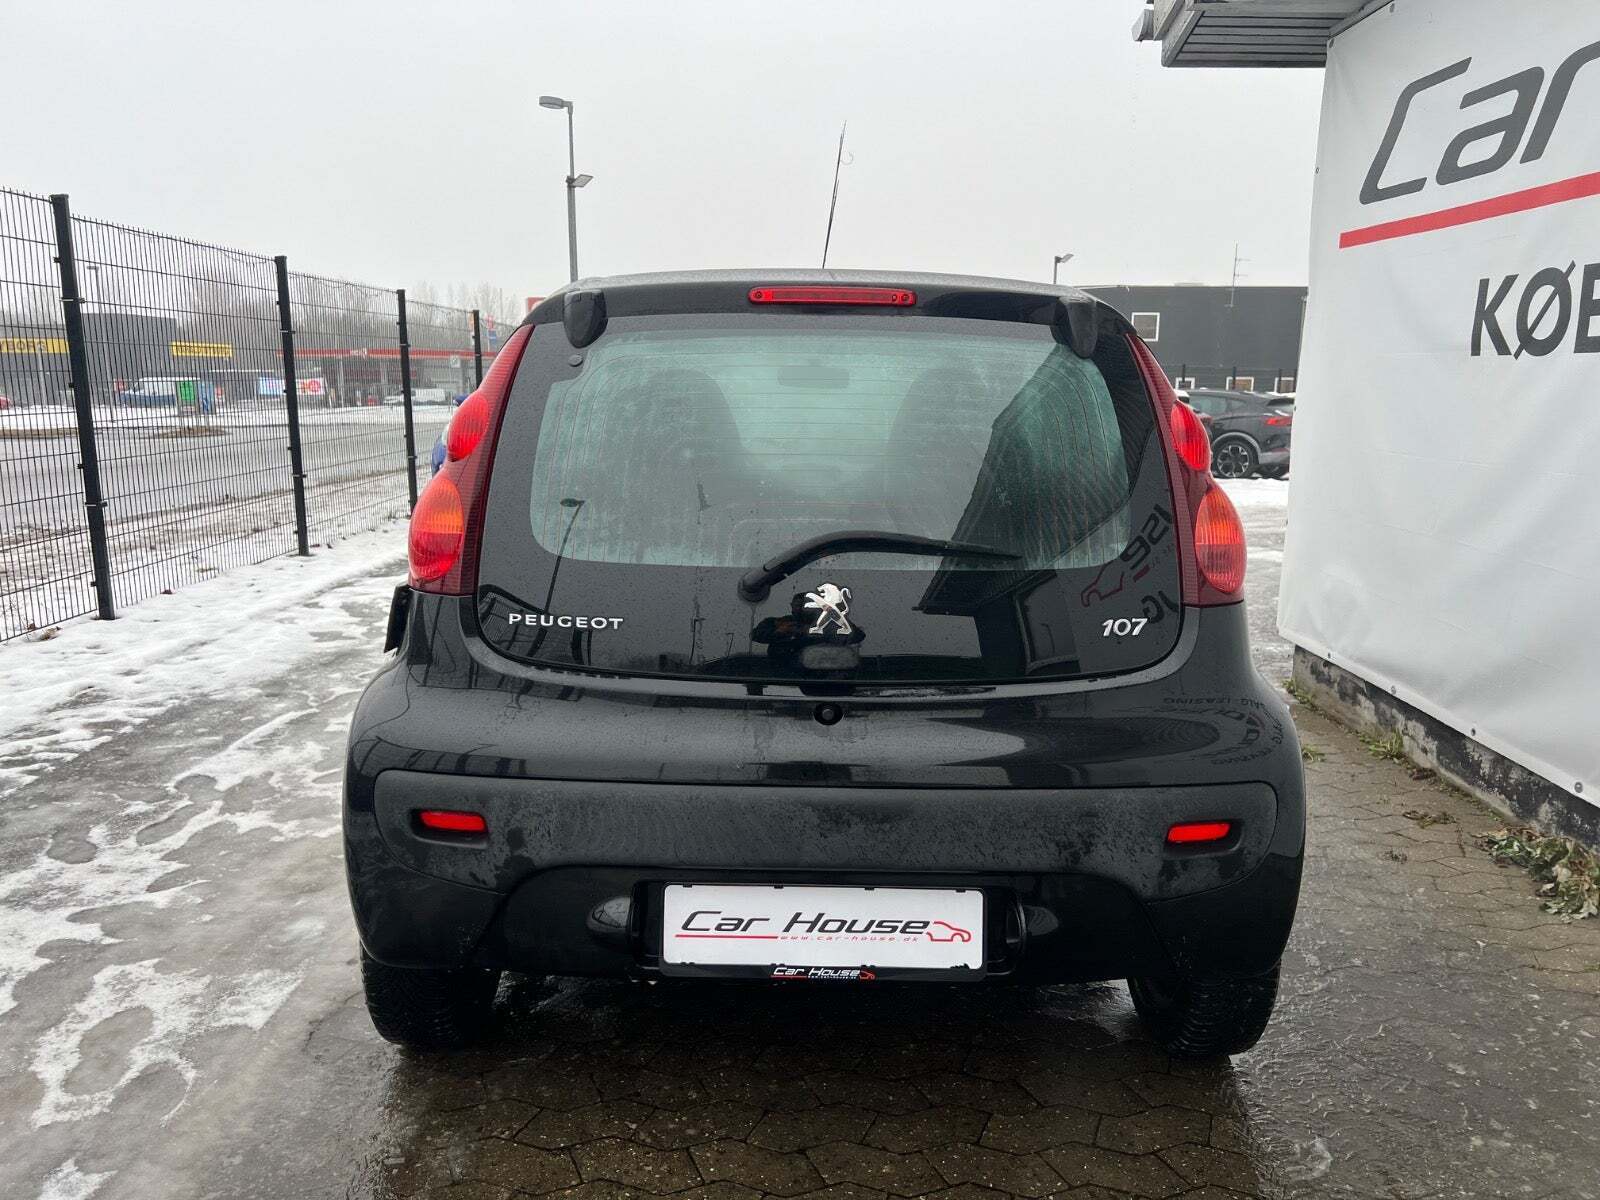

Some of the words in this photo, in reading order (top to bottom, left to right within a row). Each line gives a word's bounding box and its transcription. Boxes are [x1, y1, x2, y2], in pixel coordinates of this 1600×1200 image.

[1359, 40, 1600, 205] Car
[508, 613, 624, 630] PEUGEOT
[1102, 617, 1148, 637] 107
[681, 910, 770, 933] Car
[782, 911, 931, 935] House
[773, 967, 805, 976] Car
[808, 967, 861, 977] House
